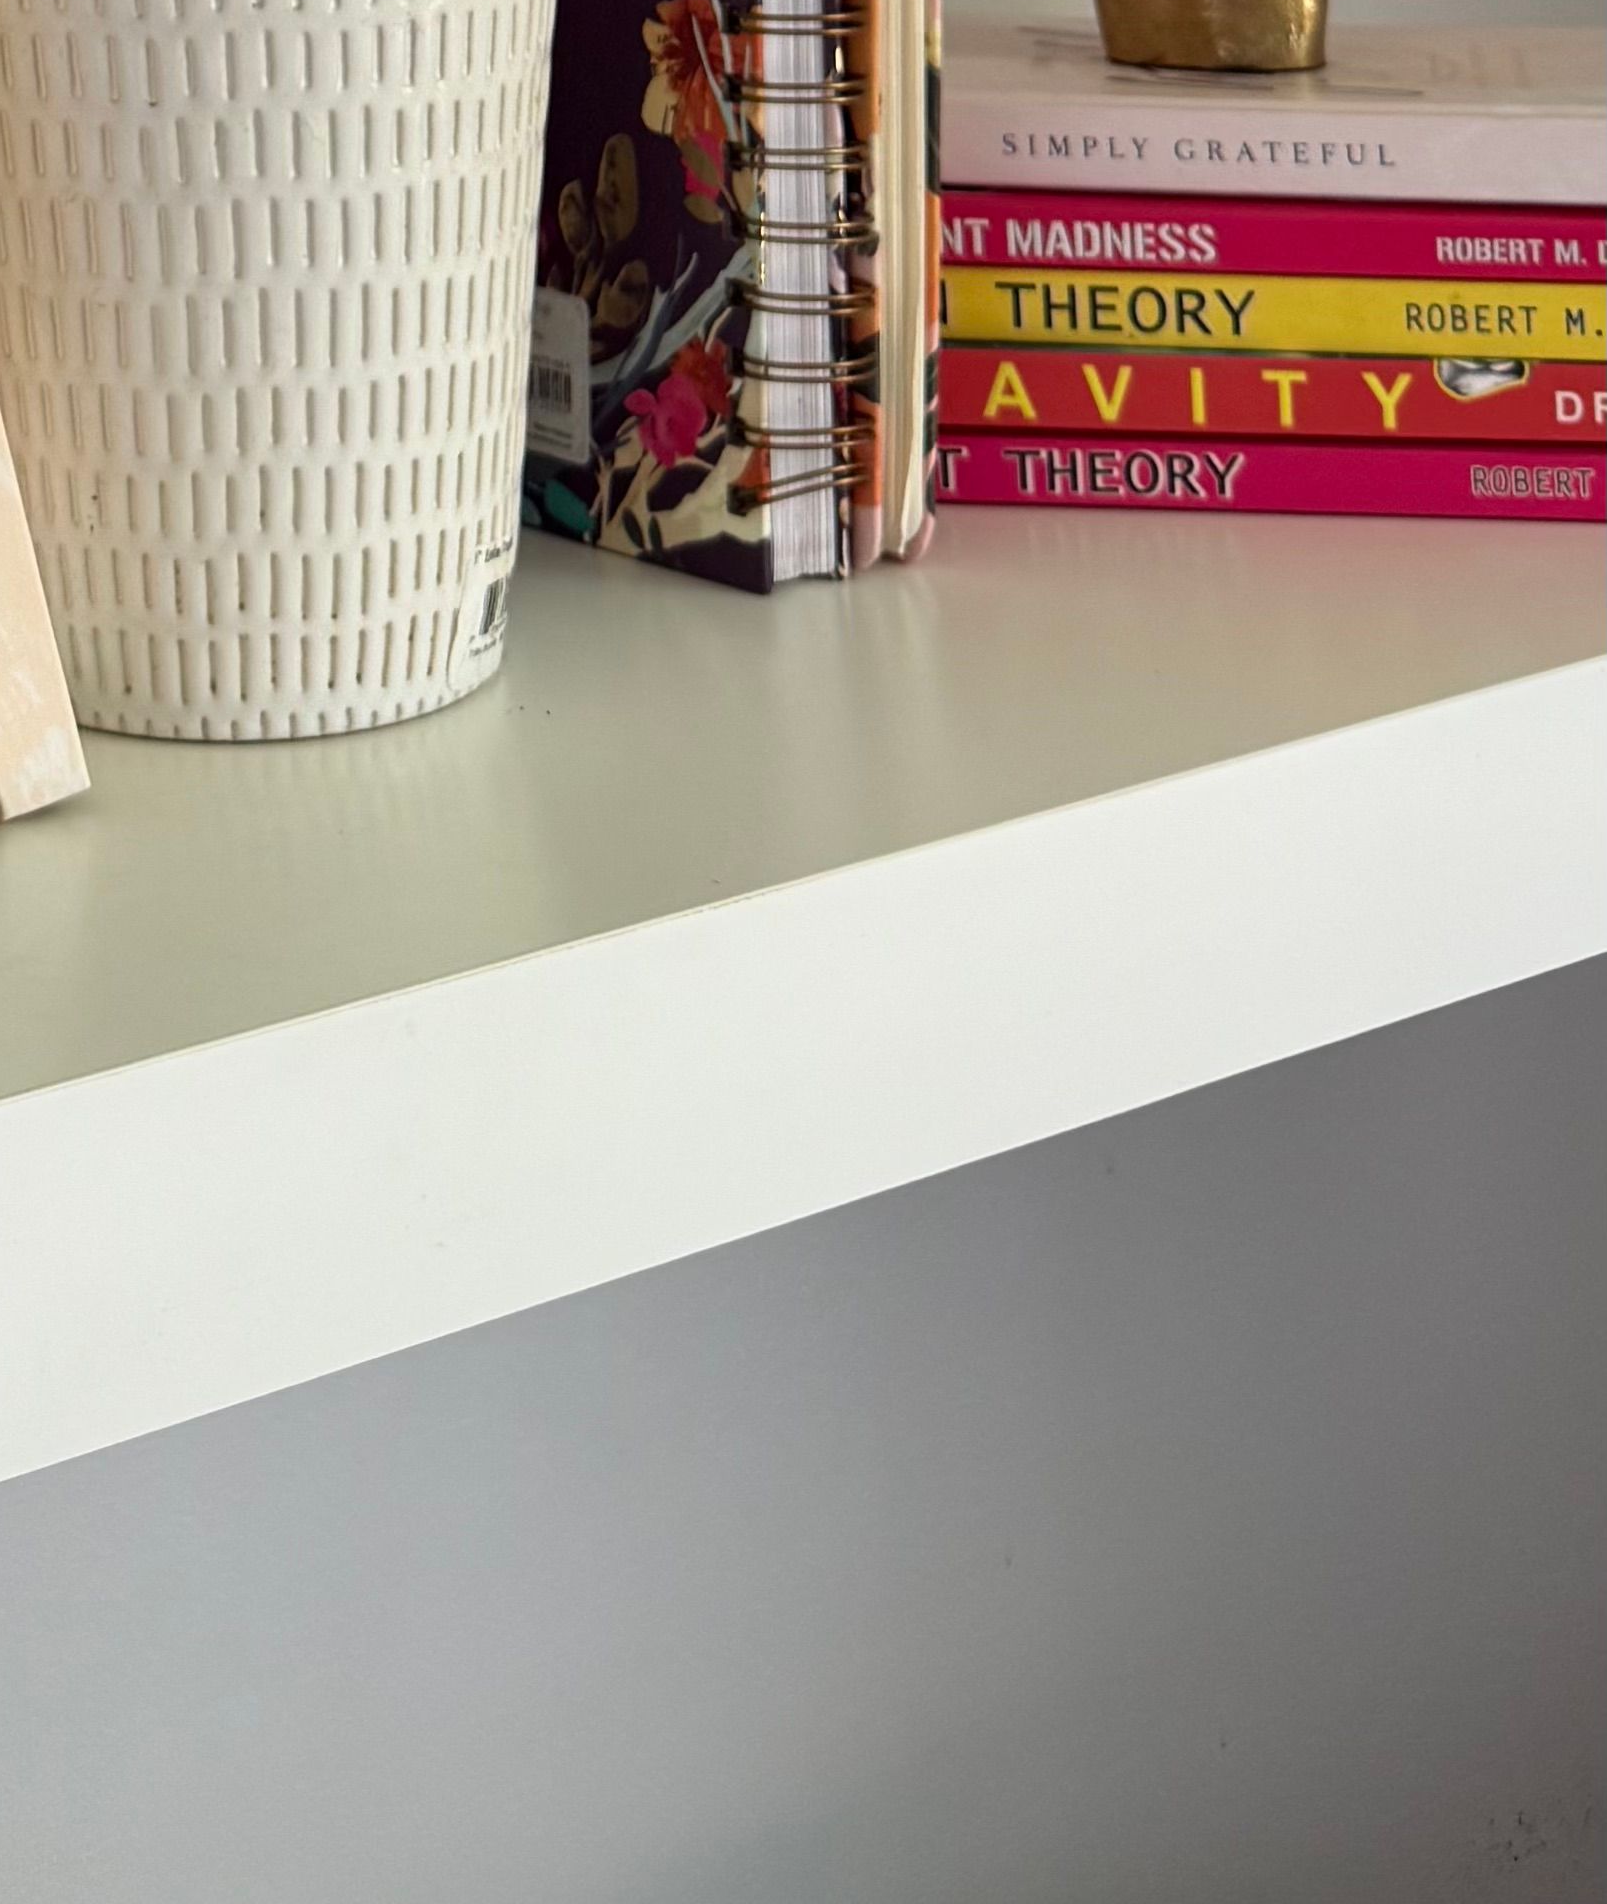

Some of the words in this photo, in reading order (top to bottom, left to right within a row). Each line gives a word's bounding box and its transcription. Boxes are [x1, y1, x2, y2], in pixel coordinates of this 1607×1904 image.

[1001, 132, 1152, 161] SIMPLY
[1173, 136, 1397, 168] GRATEFUL
[1005, 219, 1218, 263] MADNESS
[1435, 236, 1544, 265] ROBERT
[1554, 238, 1588, 266] M.
[994, 280, 1255, 338] THEORY
[1405, 302, 1538, 336] ROBERT
[1565, 308, 1604, 338] M.
[1002, 448, 1244, 502] THEORY
[1470, 464, 1594, 498] ROBERT
